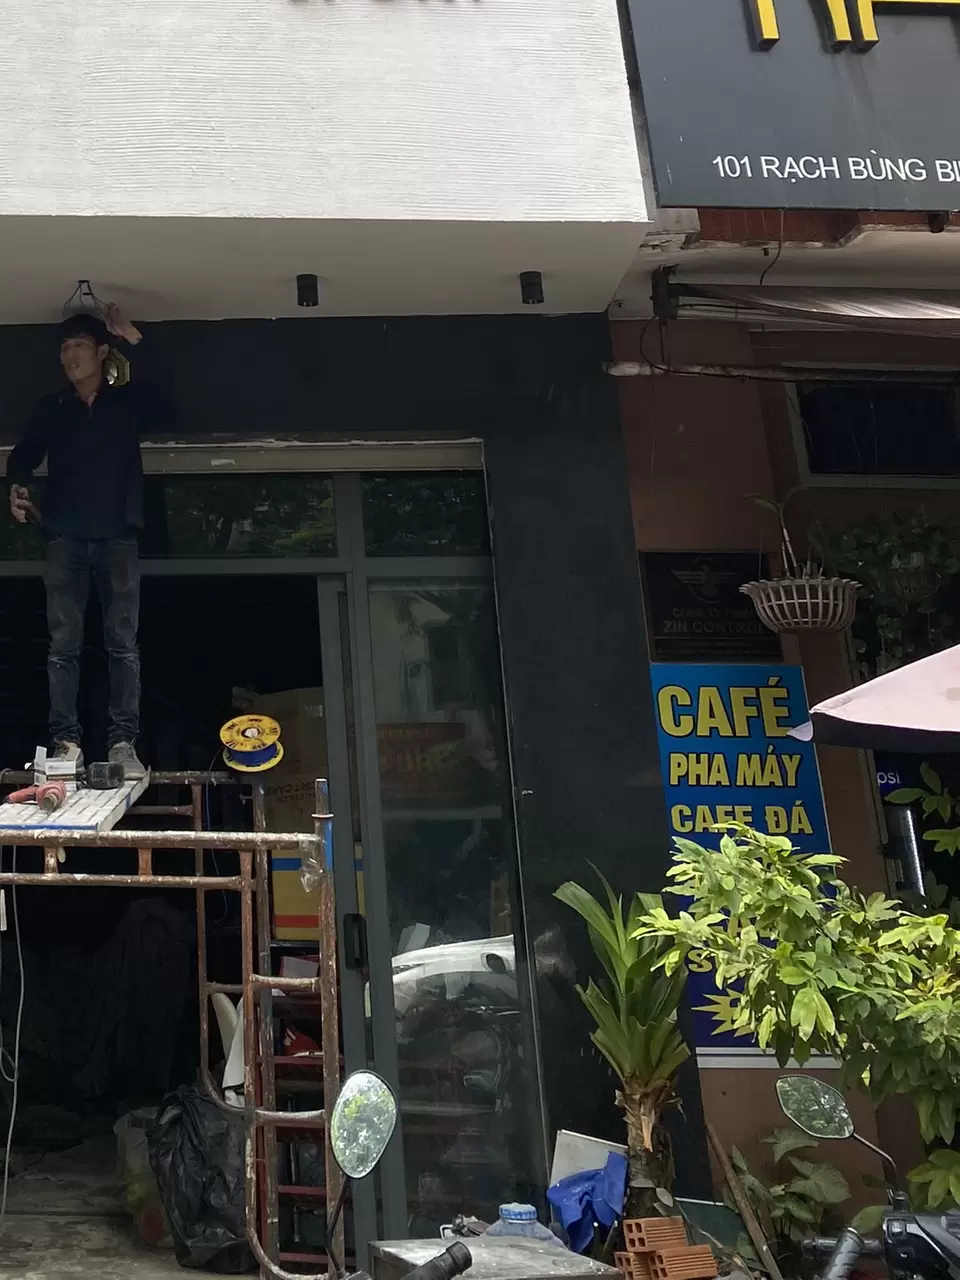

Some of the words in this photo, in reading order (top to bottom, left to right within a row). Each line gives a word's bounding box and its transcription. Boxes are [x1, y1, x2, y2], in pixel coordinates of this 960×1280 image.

[712, 155, 754, 178] 101
[760, 156, 841, 183] RẠCH
[849, 150, 927, 181] BÙNG
[935, 160, 960, 182] BI
[657, 676, 793, 738] CAFÉ
[668, 752, 731, 787] PHA
[735, 744, 803, 787] MÁY
[876, 770, 900, 787] psi
[670, 804, 755, 834] CAFE
[764, 799, 814, 834] ĐÁ
